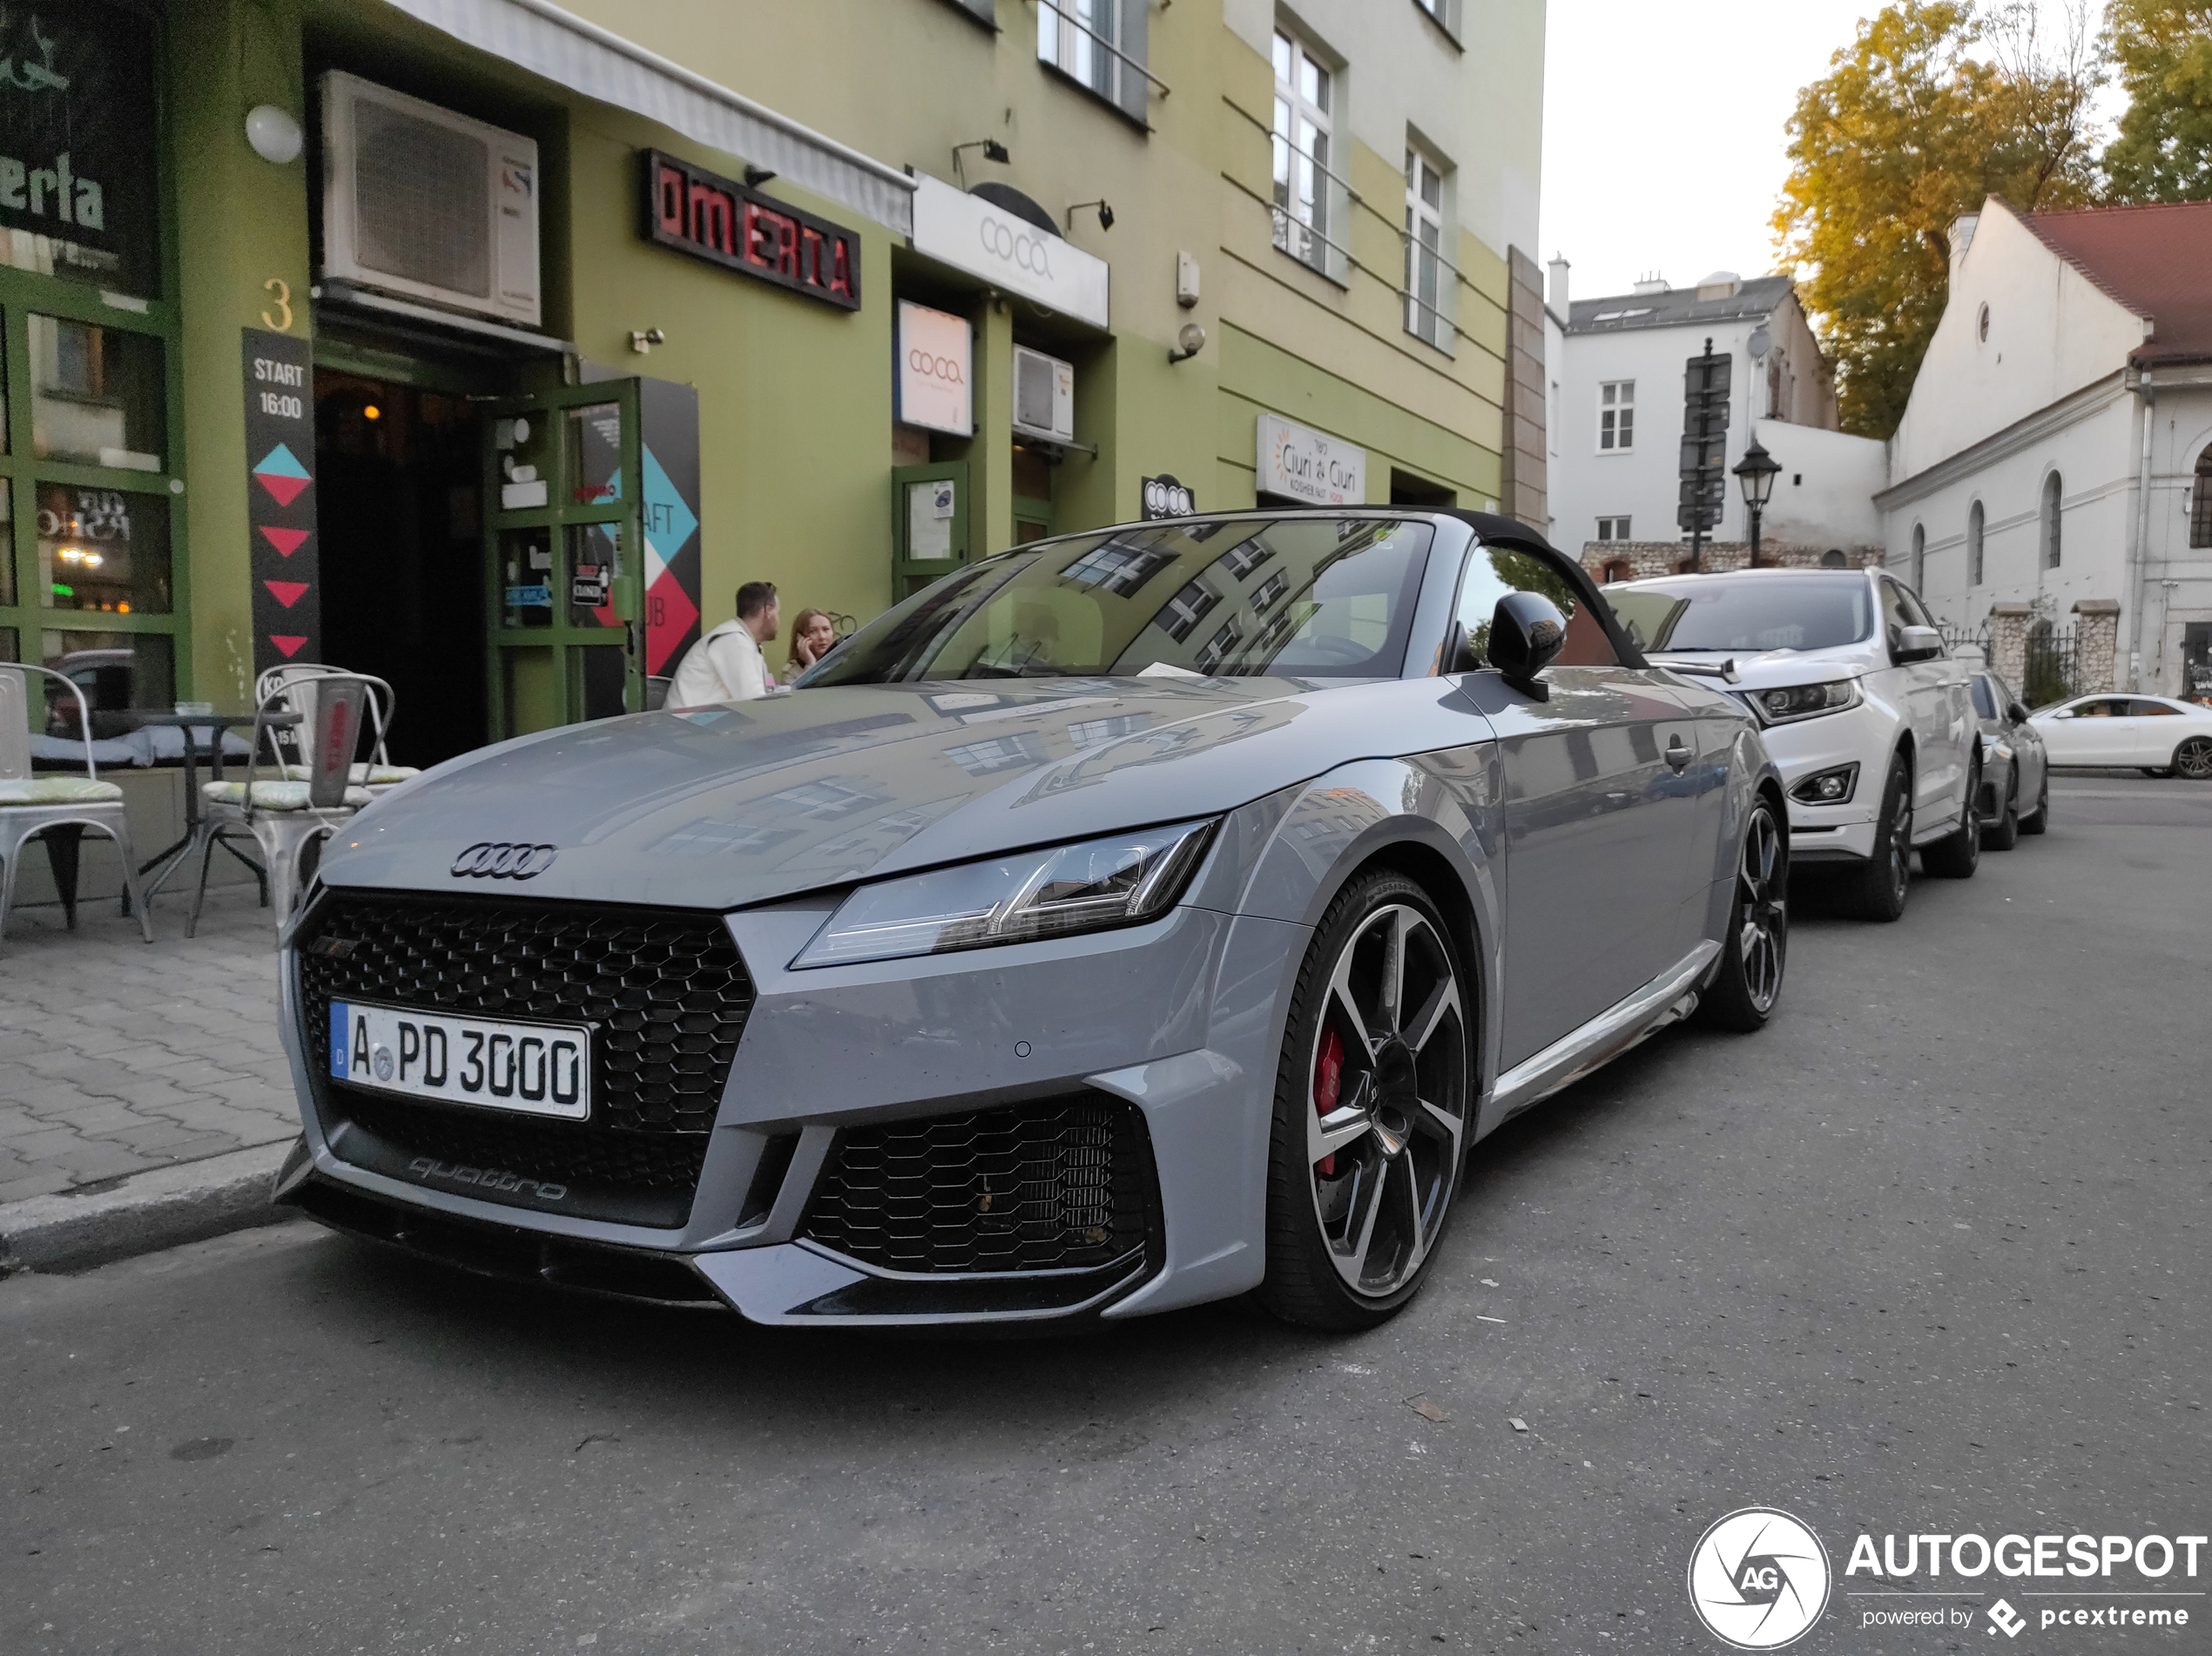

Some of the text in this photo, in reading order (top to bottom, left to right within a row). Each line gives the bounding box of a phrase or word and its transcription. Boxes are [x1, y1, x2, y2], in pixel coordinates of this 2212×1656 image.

[659, 166, 853, 298] OMERTA
[262, 278, 293, 332] 3
[253, 357, 303, 387] START
[260, 391, 301, 419] 16:00
[1283, 443, 1312, 478] Ciuri
[1330, 459, 1355, 491] Ciuri
[336, 1048, 344, 1065] D
[352, 1015, 579, 1105] A PD 3000
[409, 1159, 568, 1200] quattro
